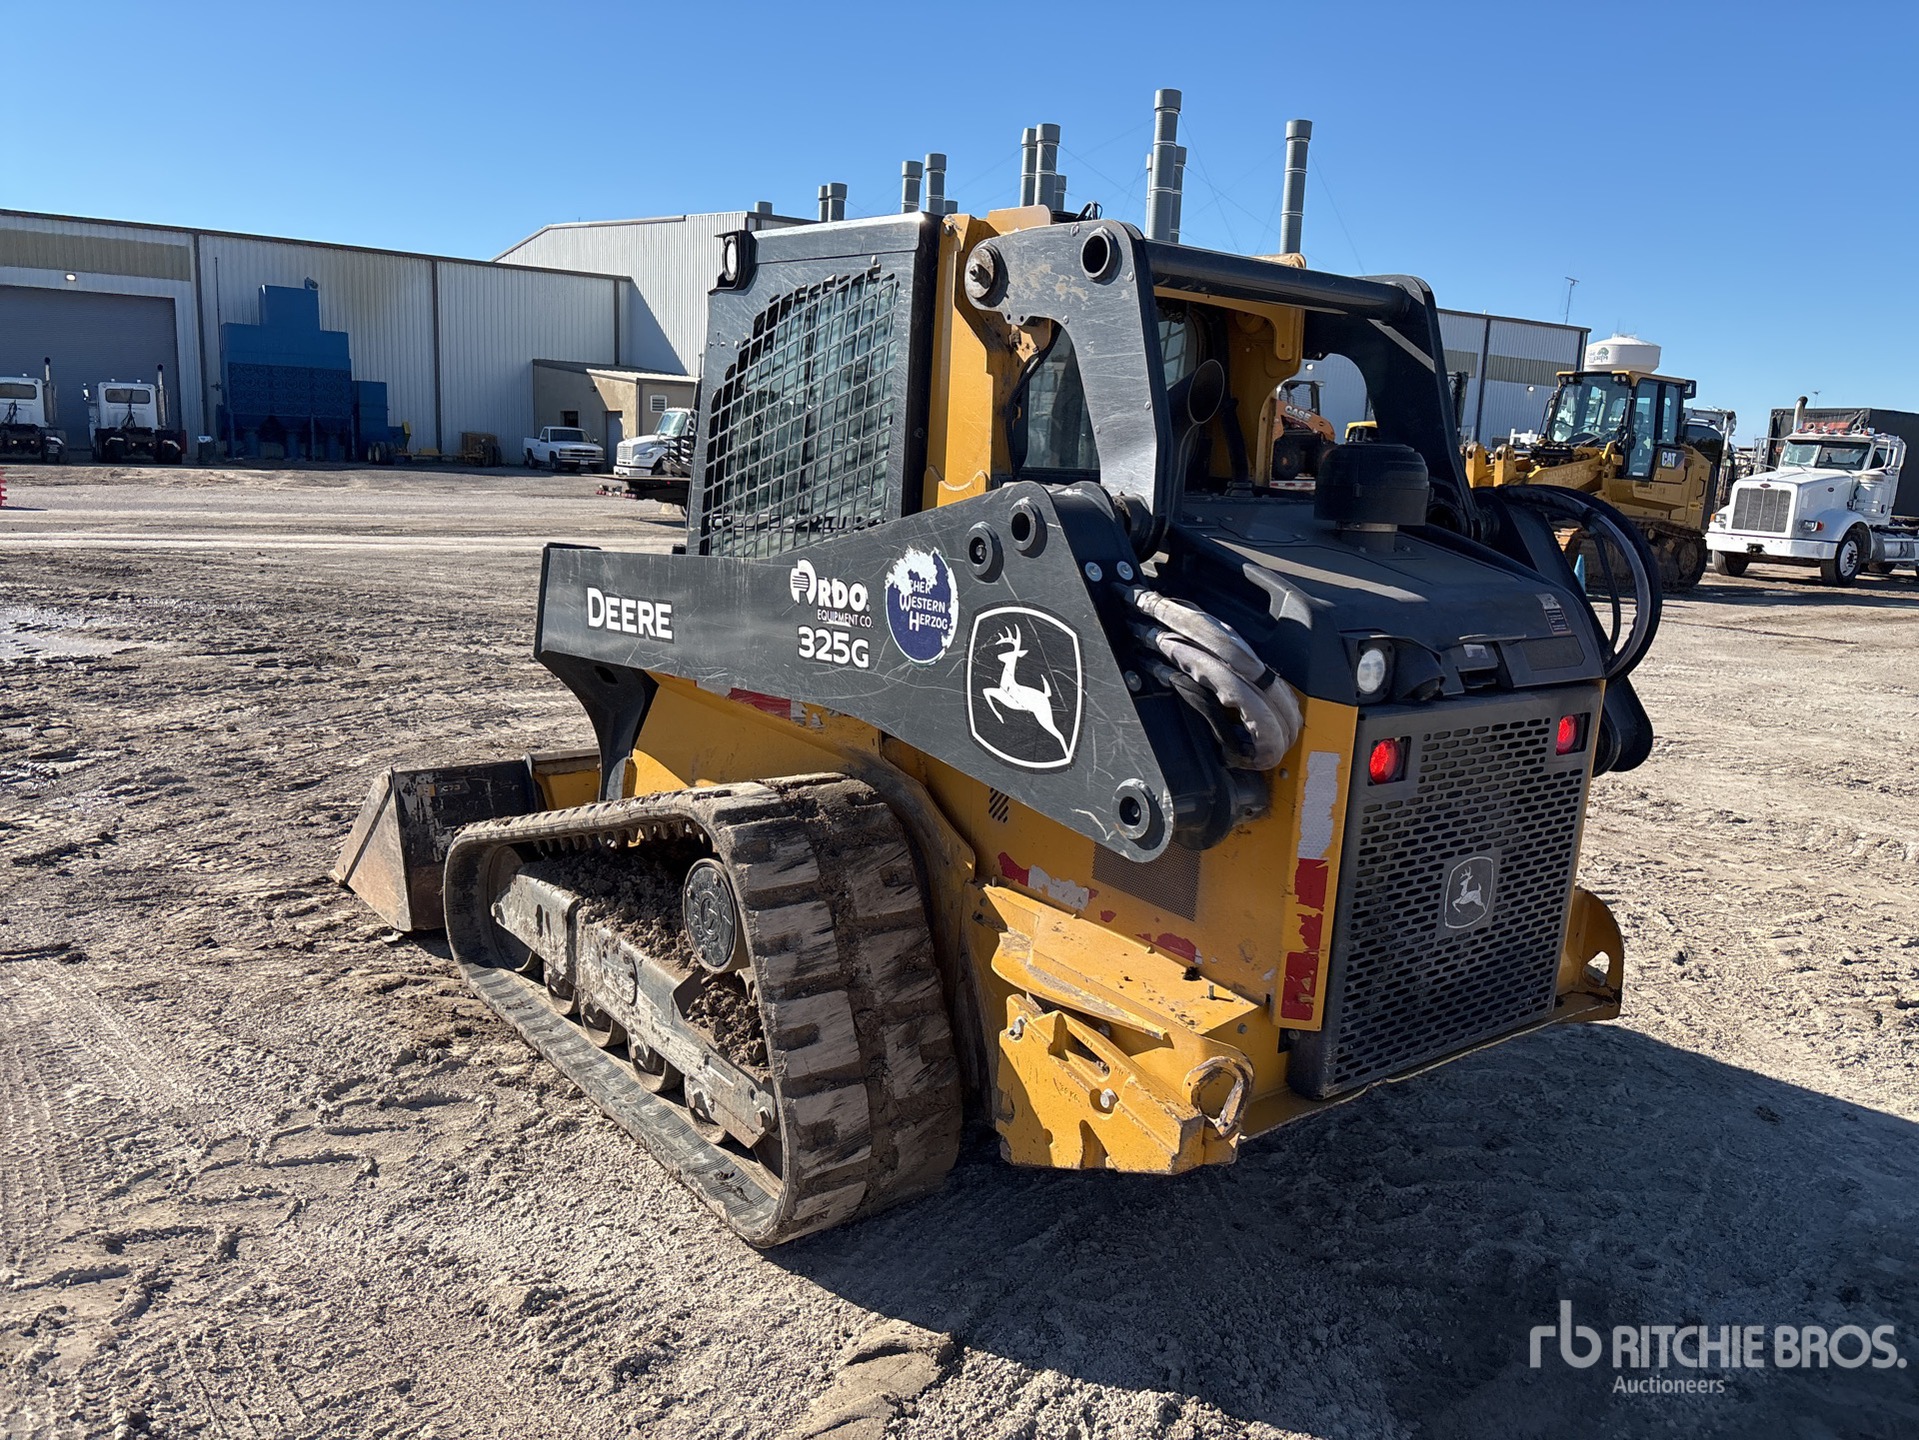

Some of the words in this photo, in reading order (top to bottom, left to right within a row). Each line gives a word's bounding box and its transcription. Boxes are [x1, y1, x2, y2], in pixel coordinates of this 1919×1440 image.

[1285, 405, 1311, 420] CASE
[1661, 451, 1676, 468] CAT
[587, 587, 673, 640] DEERE
[900, 592, 946, 614] WESTERN
[817, 609, 858, 627] EQUIPMENT
[909, 610, 949, 632] HERZOG
[798, 626, 870, 668] 325G
